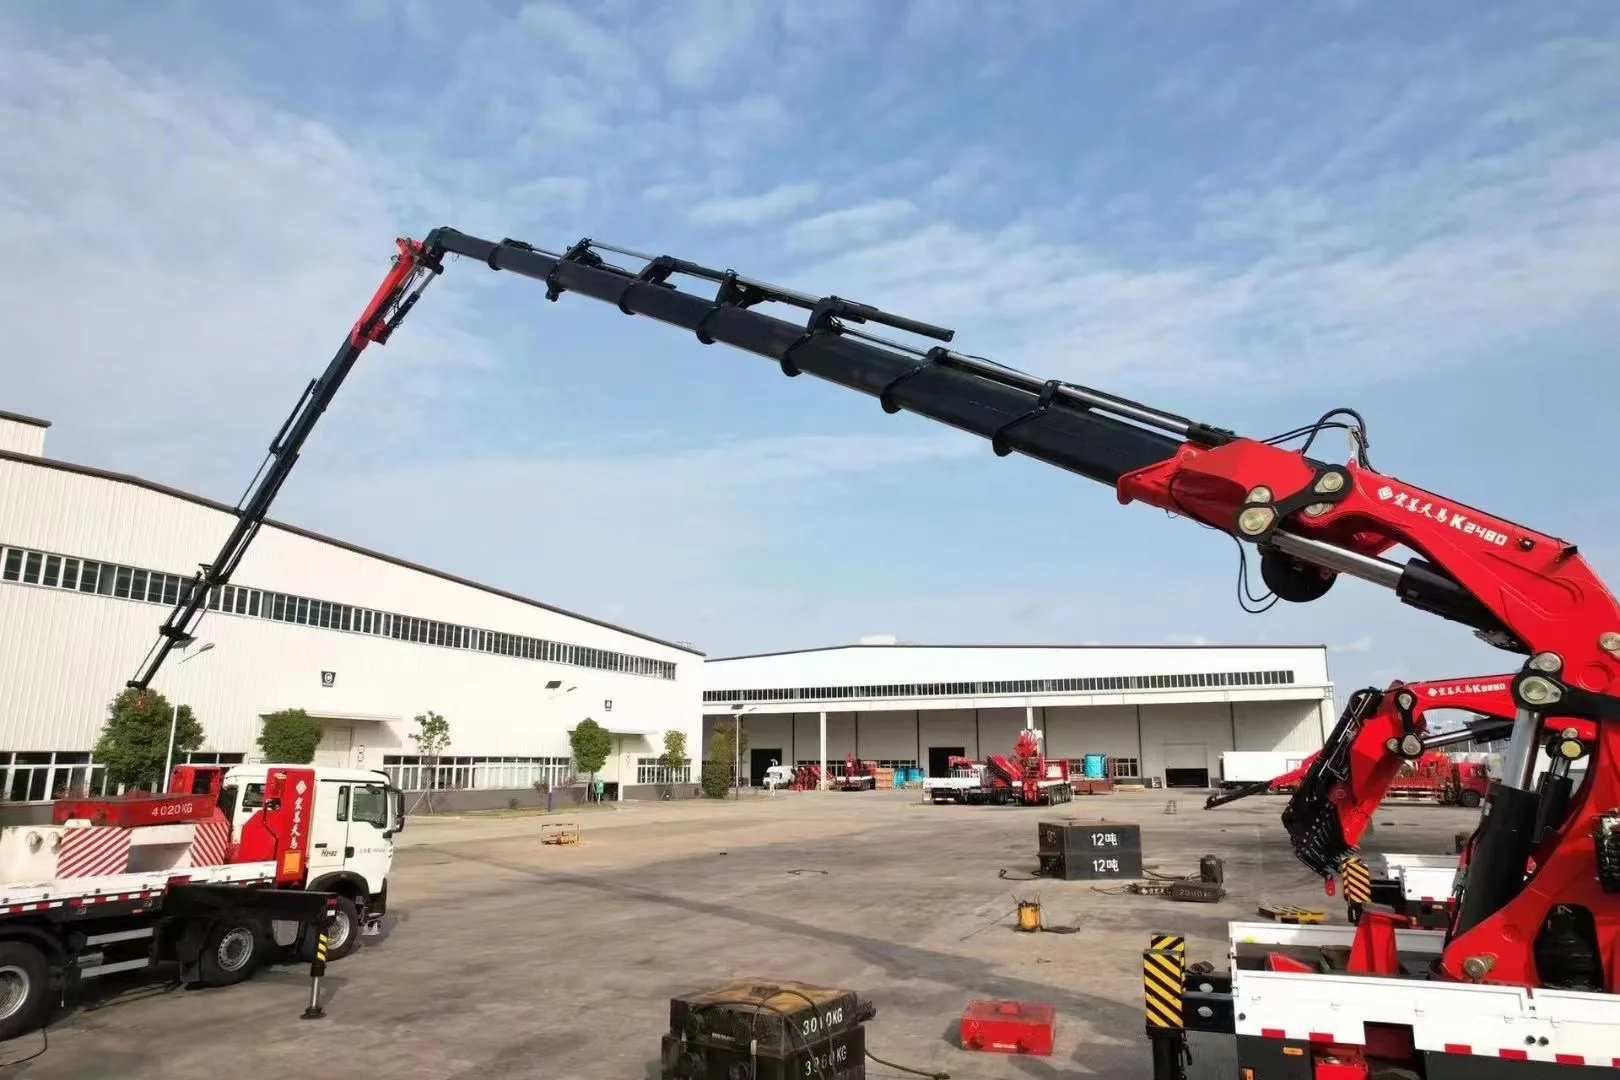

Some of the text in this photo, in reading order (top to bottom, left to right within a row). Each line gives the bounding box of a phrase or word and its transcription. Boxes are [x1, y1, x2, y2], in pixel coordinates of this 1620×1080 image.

[1449, 513, 1508, 546] K2480
[151, 803, 193, 816] 4020KG
[1091, 832, 1118, 846] 12吨
[1092, 859, 1119, 872] 12吨
[803, 1007, 843, 1036] 3010KG
